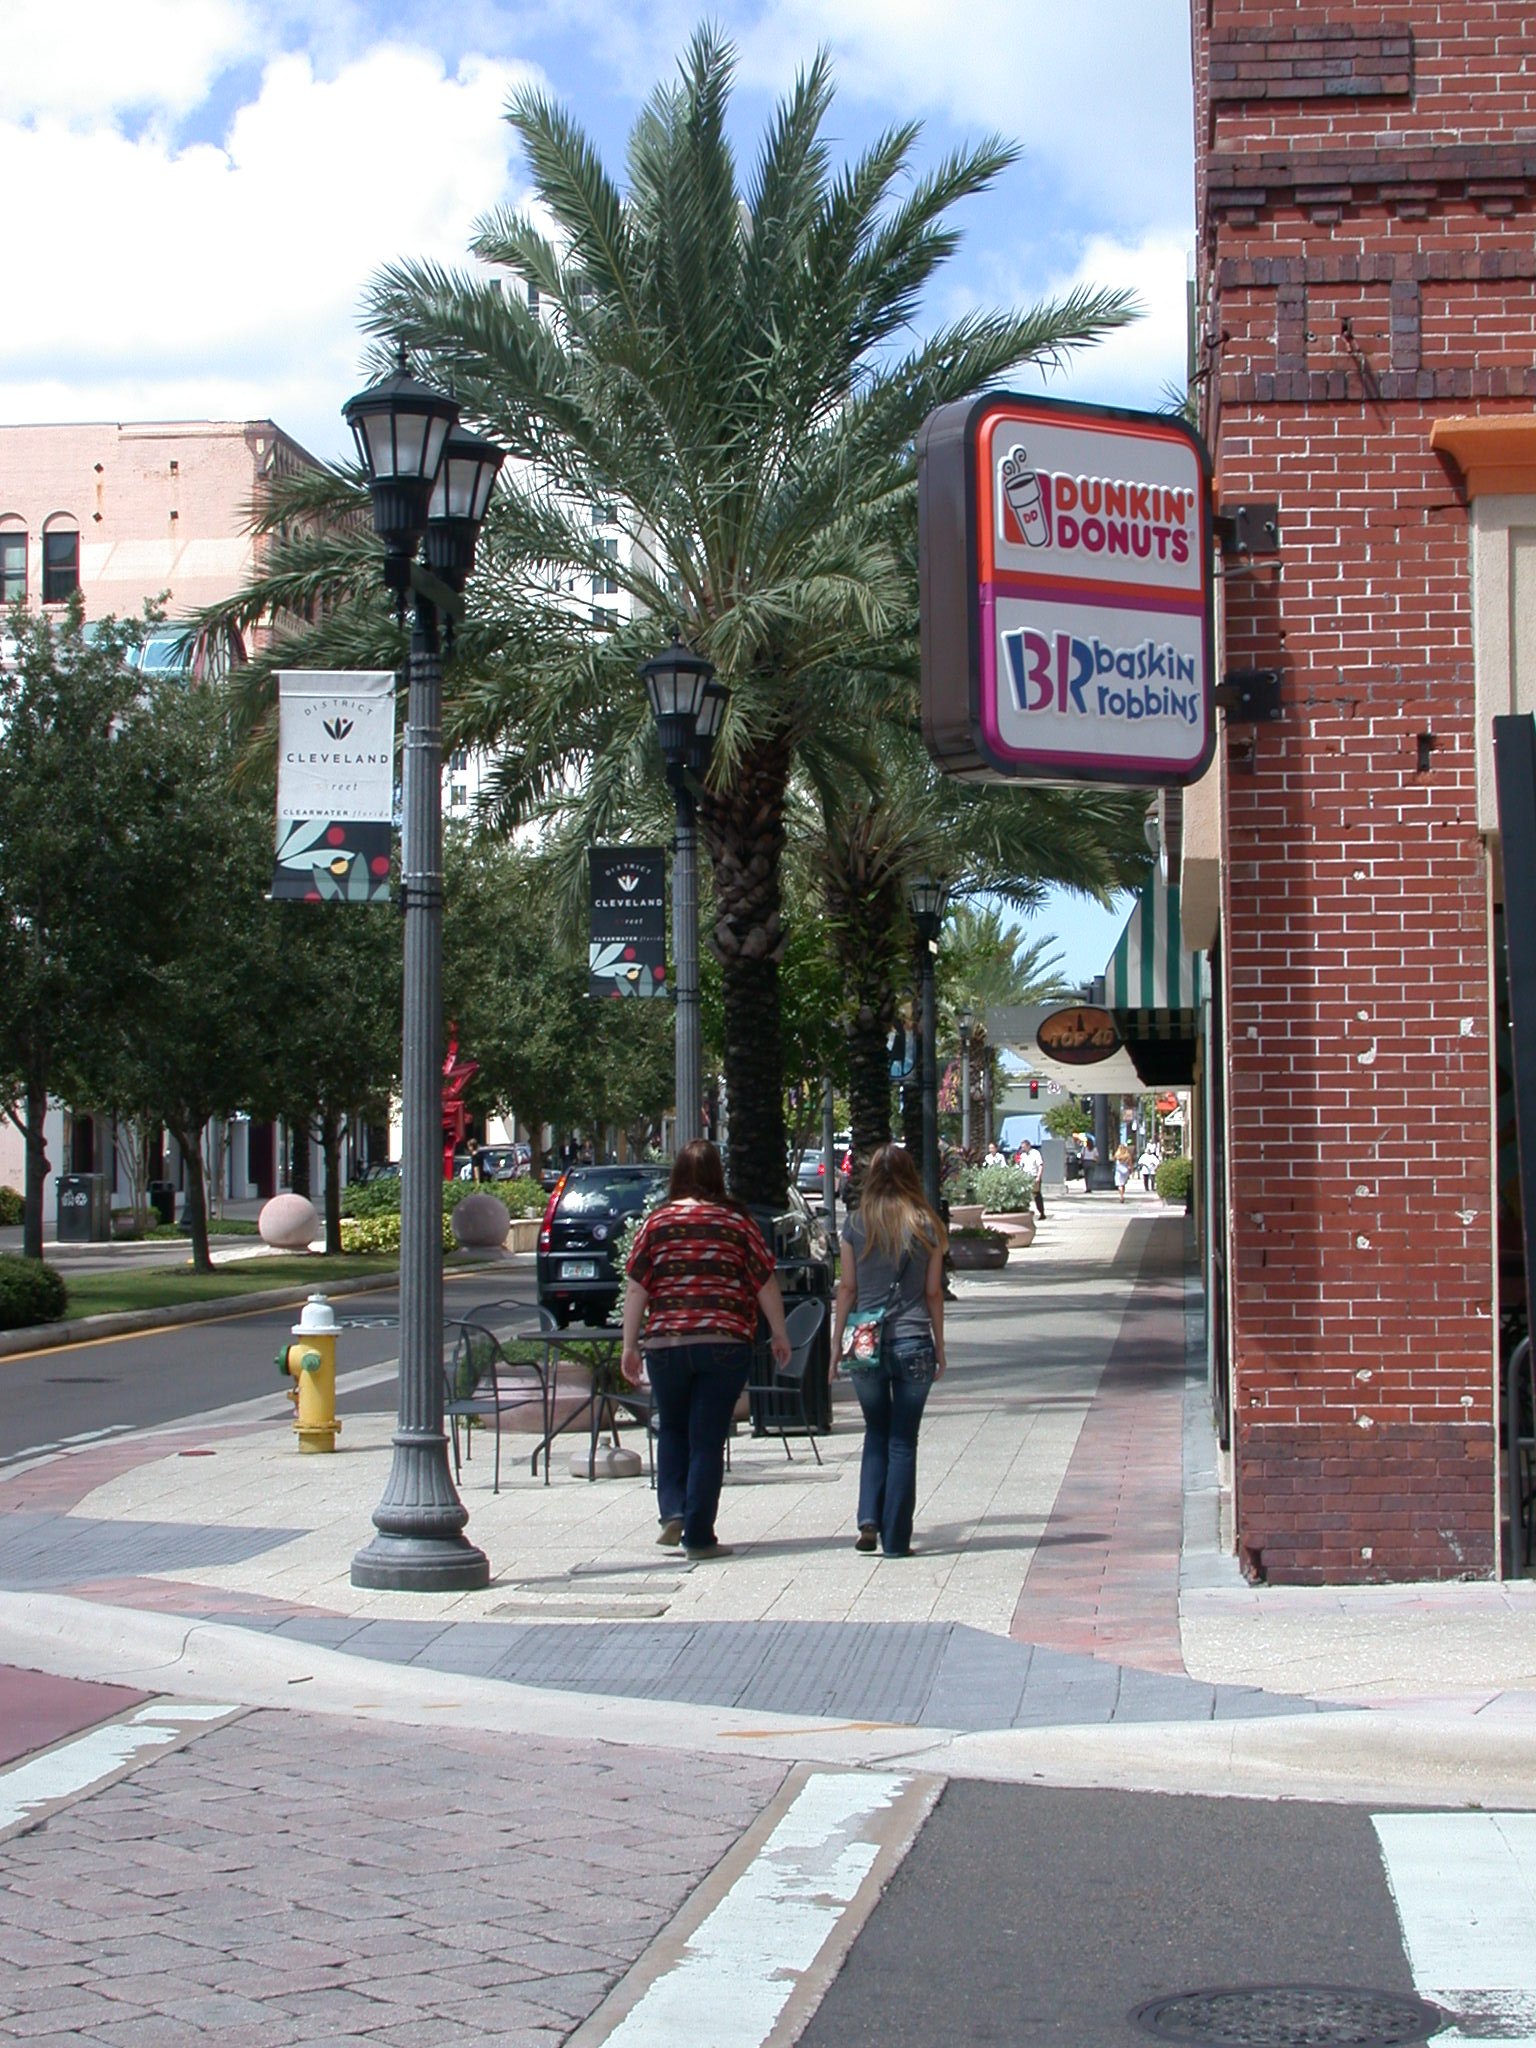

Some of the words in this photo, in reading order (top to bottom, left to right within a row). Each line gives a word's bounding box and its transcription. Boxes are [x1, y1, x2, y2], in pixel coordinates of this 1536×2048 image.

[1054, 475, 1195, 525] DUNKIN'
[1023, 510, 1038, 524] DD
[1057, 515, 1189, 563] DONUTS
[1007, 631, 1094, 714] BR
[304, 699, 373, 717] DISTRICT
[286, 753, 389, 764] CLEVELAND
[594, 898, 663, 908] CLEVELAND
